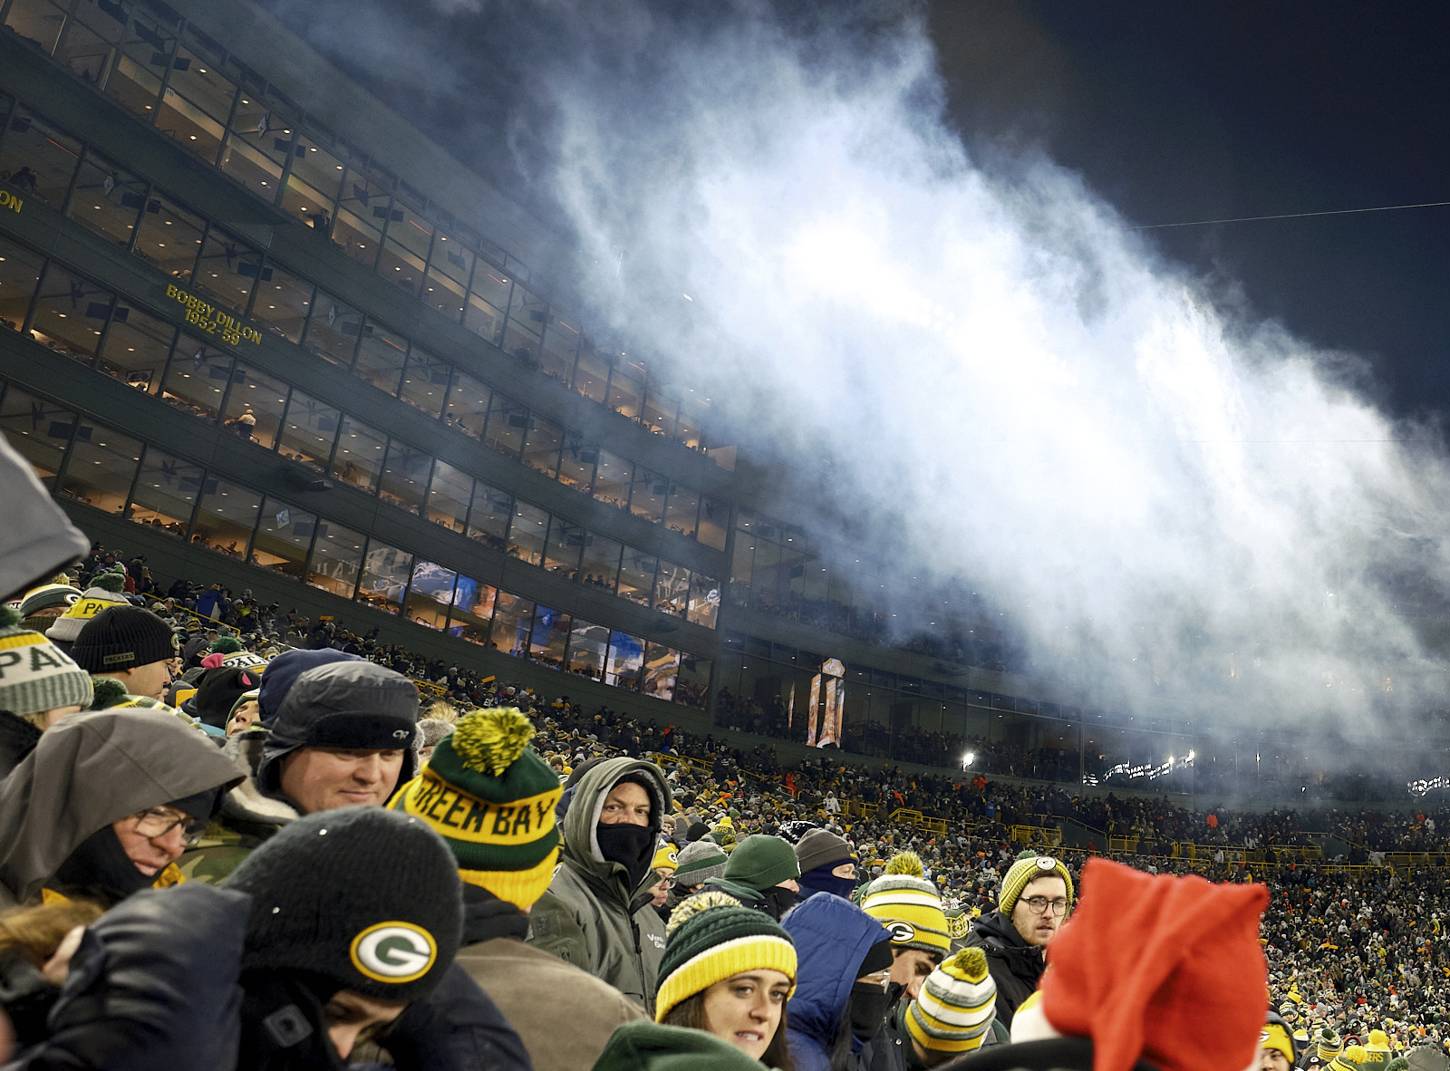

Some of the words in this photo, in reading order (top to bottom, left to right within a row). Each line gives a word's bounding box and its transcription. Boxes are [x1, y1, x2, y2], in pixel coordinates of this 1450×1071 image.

[166, 283, 215, 317] BOBBY
[216, 311, 262, 345] DILLON
[185, 308, 241, 346] 1952-59
[224, 656, 265, 667] PAC
[491, 798, 555, 835] BAY
[886, 921, 914, 942] G
[355, 924, 434, 981] G
